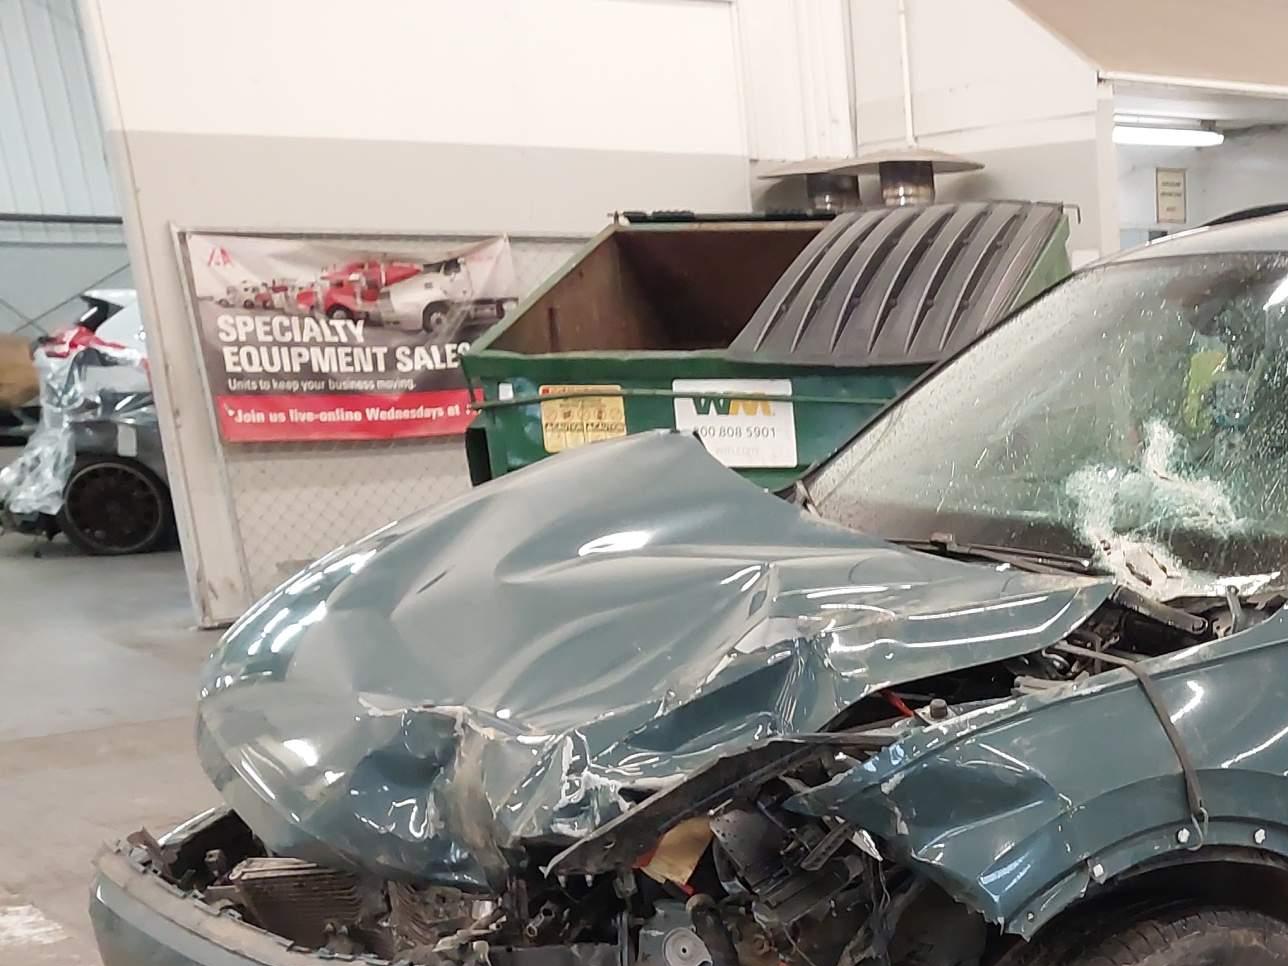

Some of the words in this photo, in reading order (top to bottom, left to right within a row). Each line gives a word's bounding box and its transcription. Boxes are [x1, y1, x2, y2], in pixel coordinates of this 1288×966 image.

[217, 314, 365, 342] SPECIALTY
[222, 345, 388, 373] EQUIPMENT
[228, 378, 258, 391] Units
[259, 379, 271, 390] to
[272, 379, 299, 392] keep
[300, 380, 326, 392] your
[234, 408, 266, 423] Join
[269, 411, 287, 423] us
[288, 407, 363, 423] live-online
[365, 405, 445, 421] Wednesdays
[446, 403, 461, 417] at
[719, 426, 742, 438] 808
[746, 426, 776, 438] 5901
